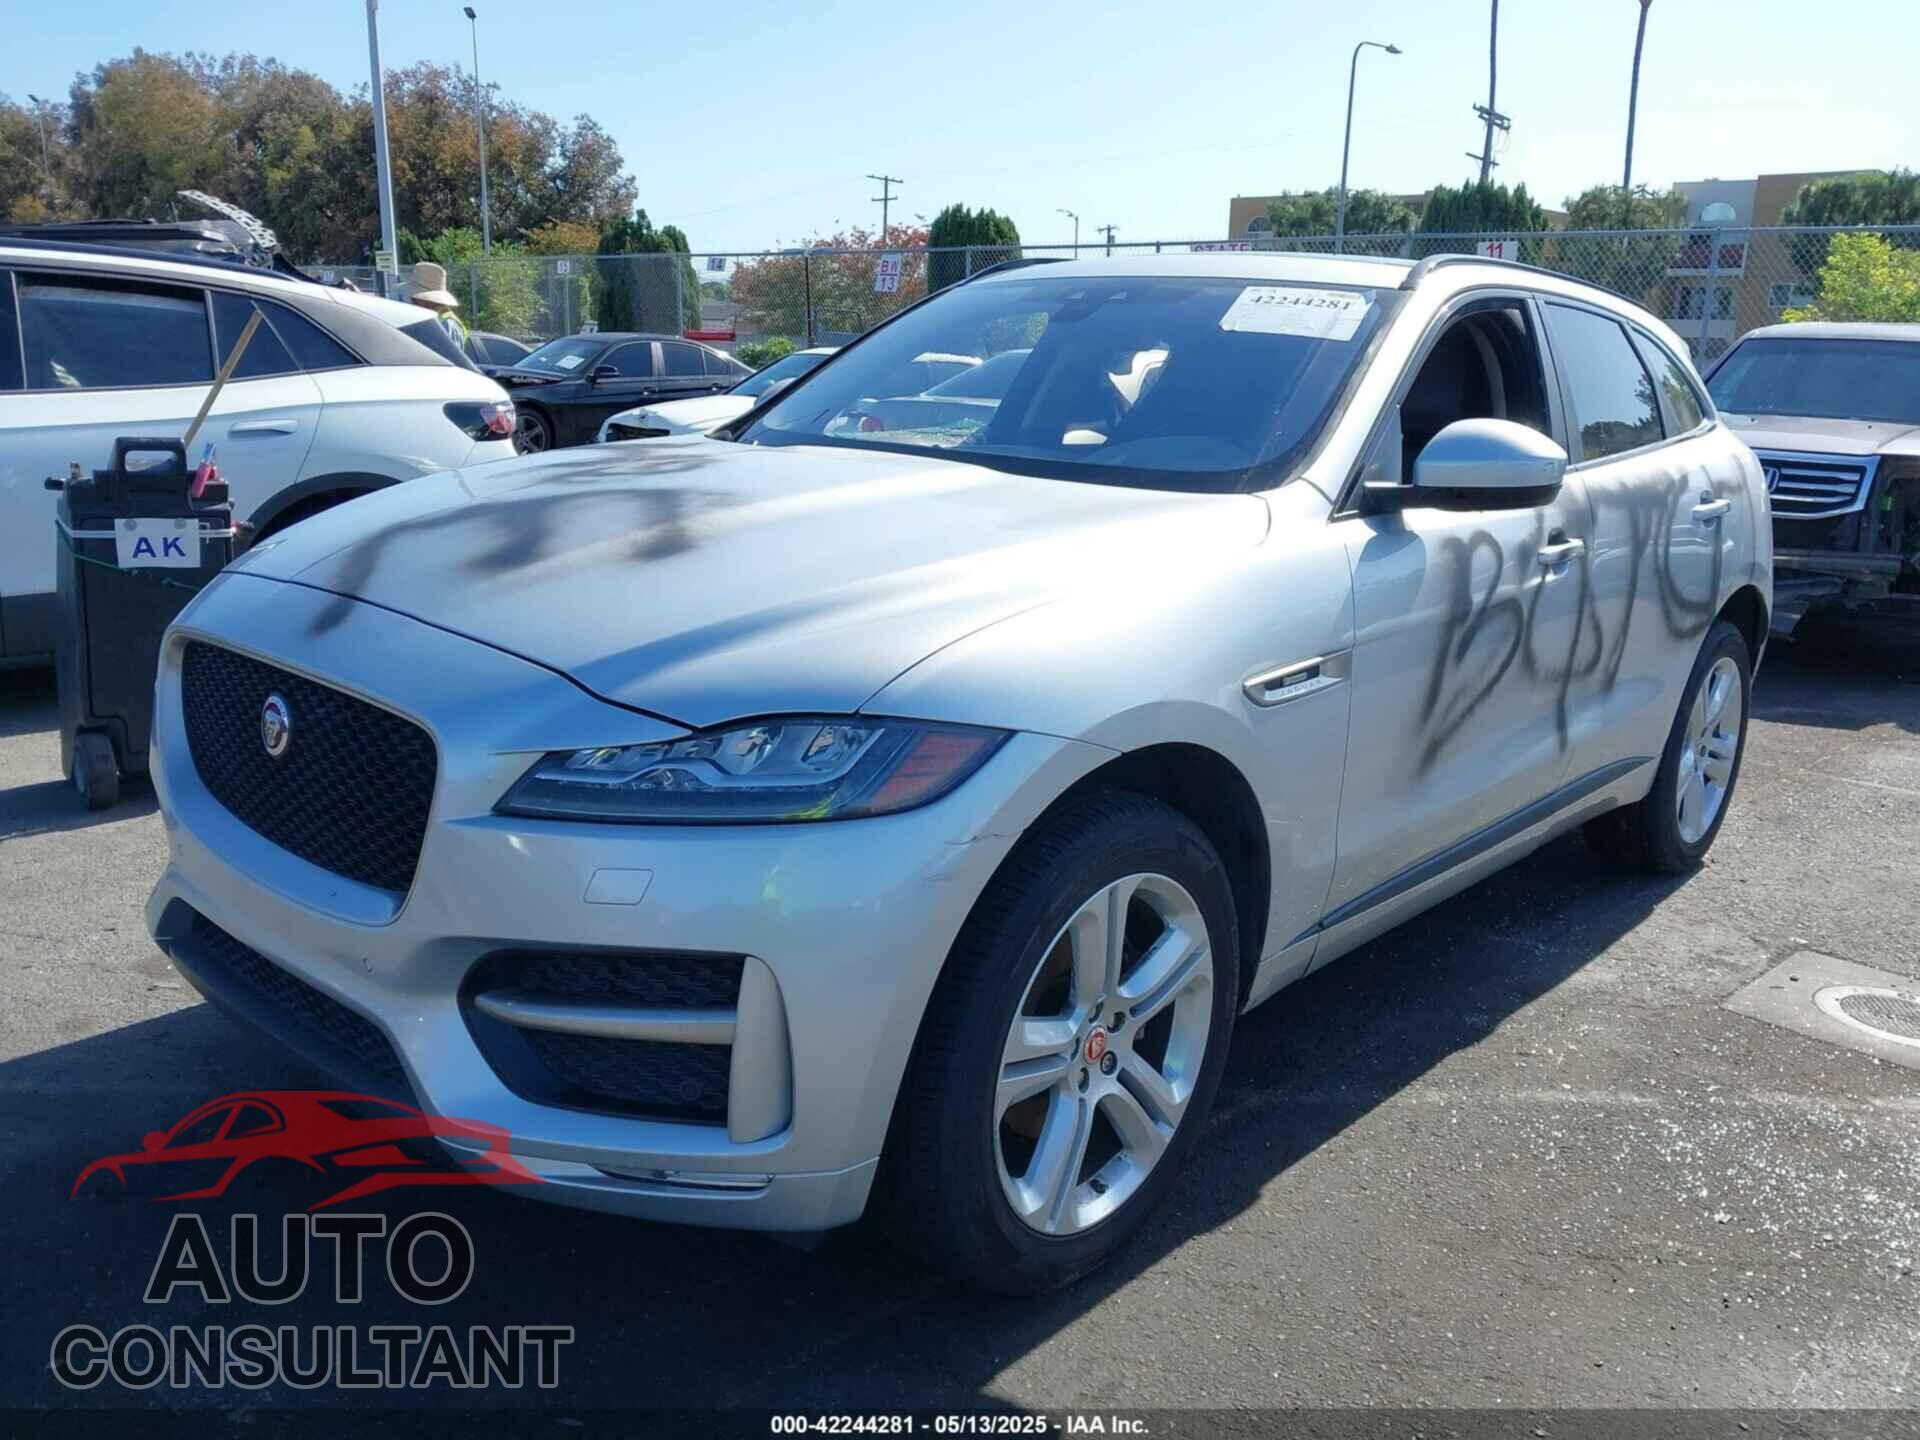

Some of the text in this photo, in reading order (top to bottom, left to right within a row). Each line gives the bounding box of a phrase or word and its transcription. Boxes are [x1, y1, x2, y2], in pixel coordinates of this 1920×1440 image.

[1486, 242, 1504, 259] 11
[881, 276, 896, 290] 13
[1250, 295, 1352, 311] 42244281
